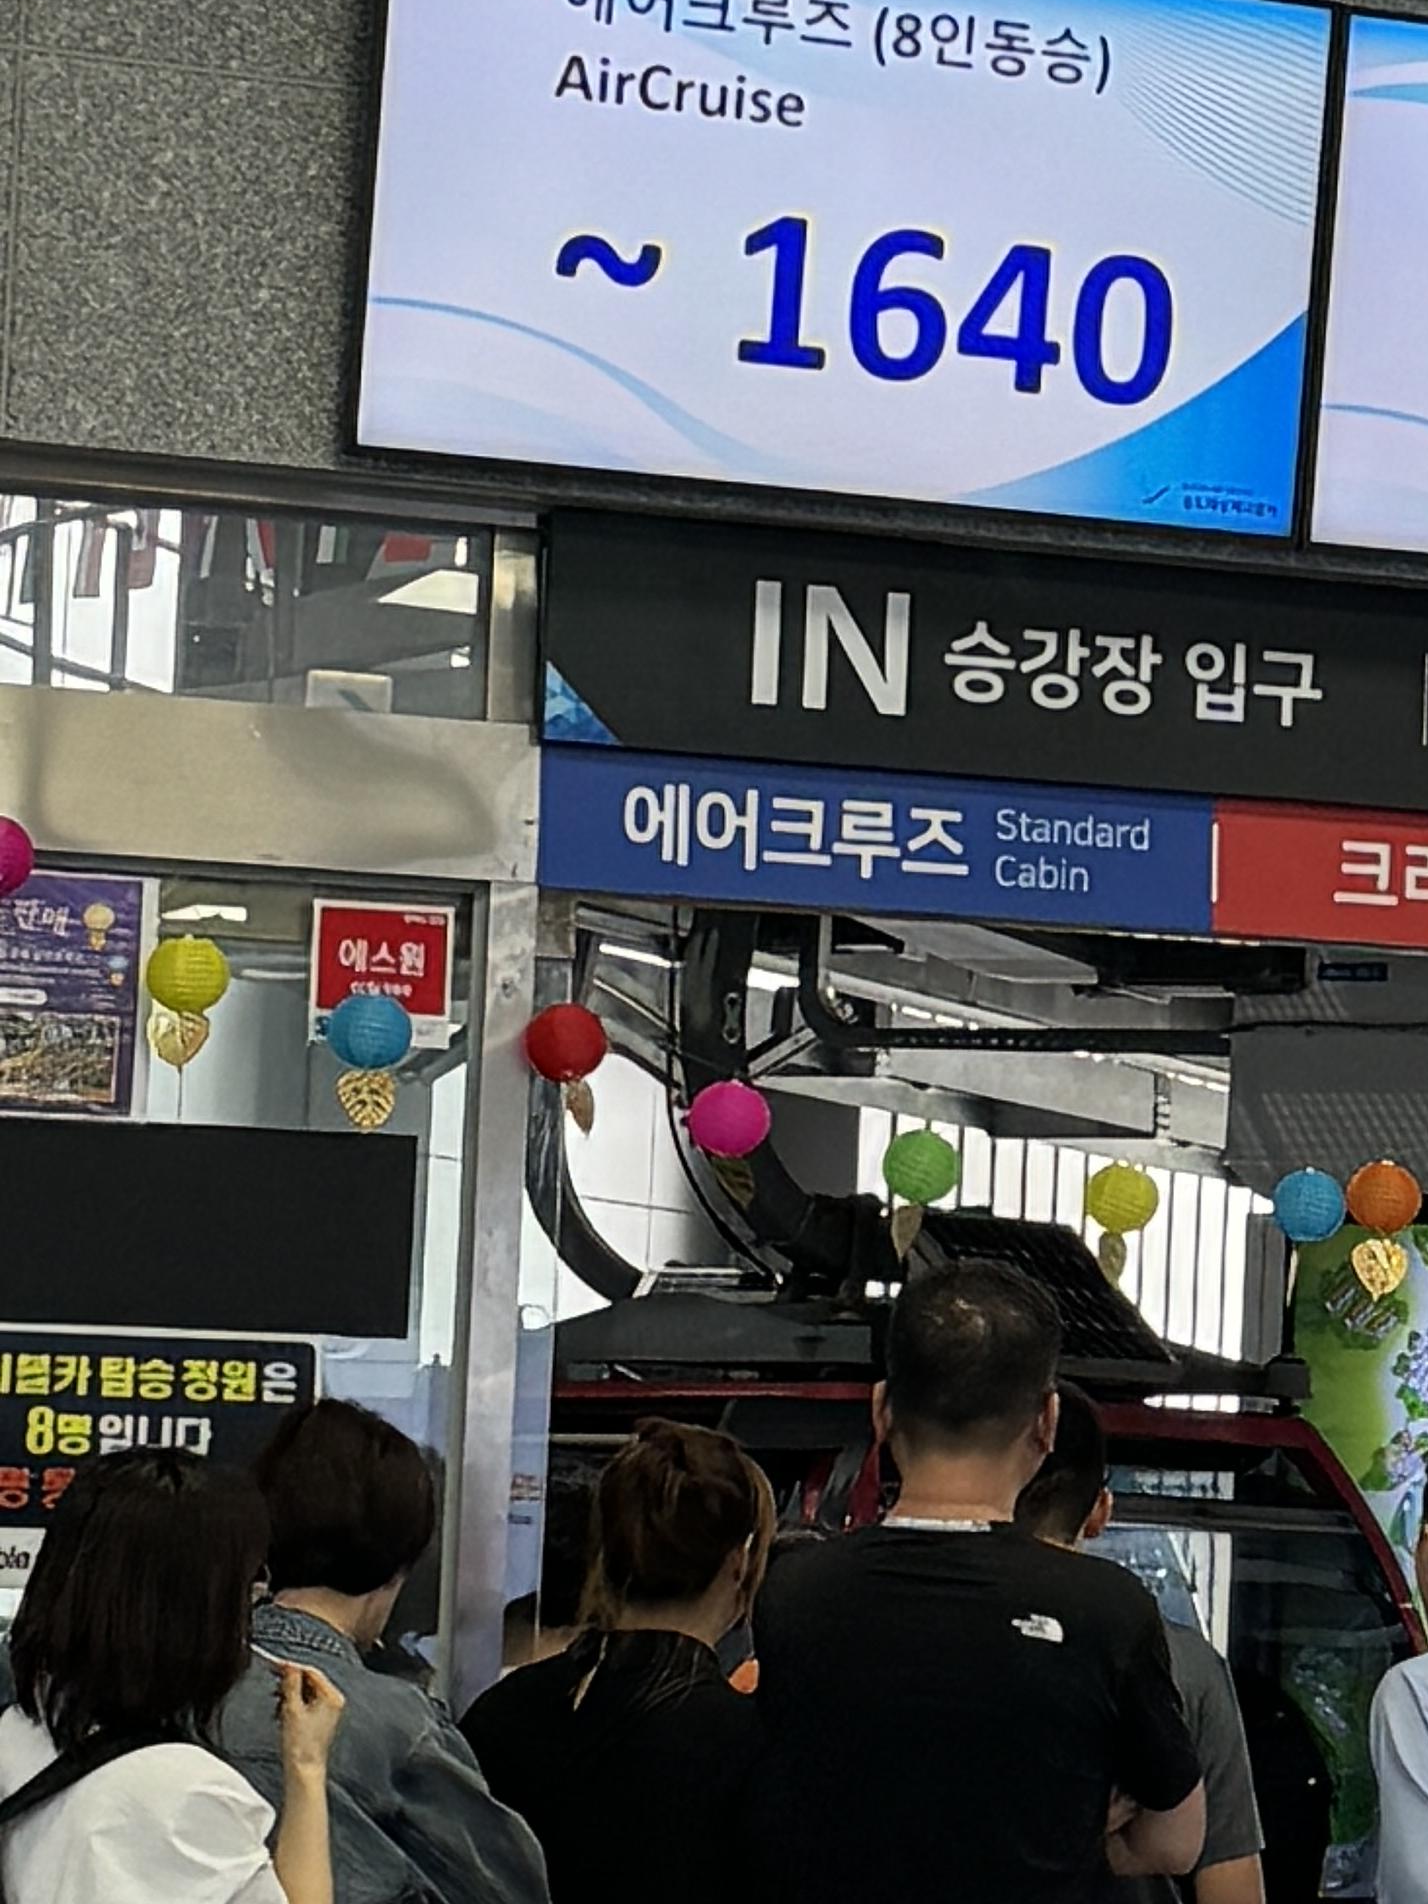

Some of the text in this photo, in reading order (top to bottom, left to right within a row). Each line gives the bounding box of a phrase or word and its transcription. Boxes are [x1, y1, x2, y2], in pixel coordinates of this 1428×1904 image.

[872, 1, 1112, 94] (8인동승)
[553, 53, 806, 131] AirCruise
[736, 212, 1174, 408] 1640
[749, 579, 1322, 728] IN 승강장 입구
[622, 783, 970, 879] 에어크루즈
[995, 807, 1151, 851] Standard
[994, 851, 1091, 893] Cabin
[100, 1356, 175, 1401] 탑승
[181, 1359, 297, 1404] 정원은
